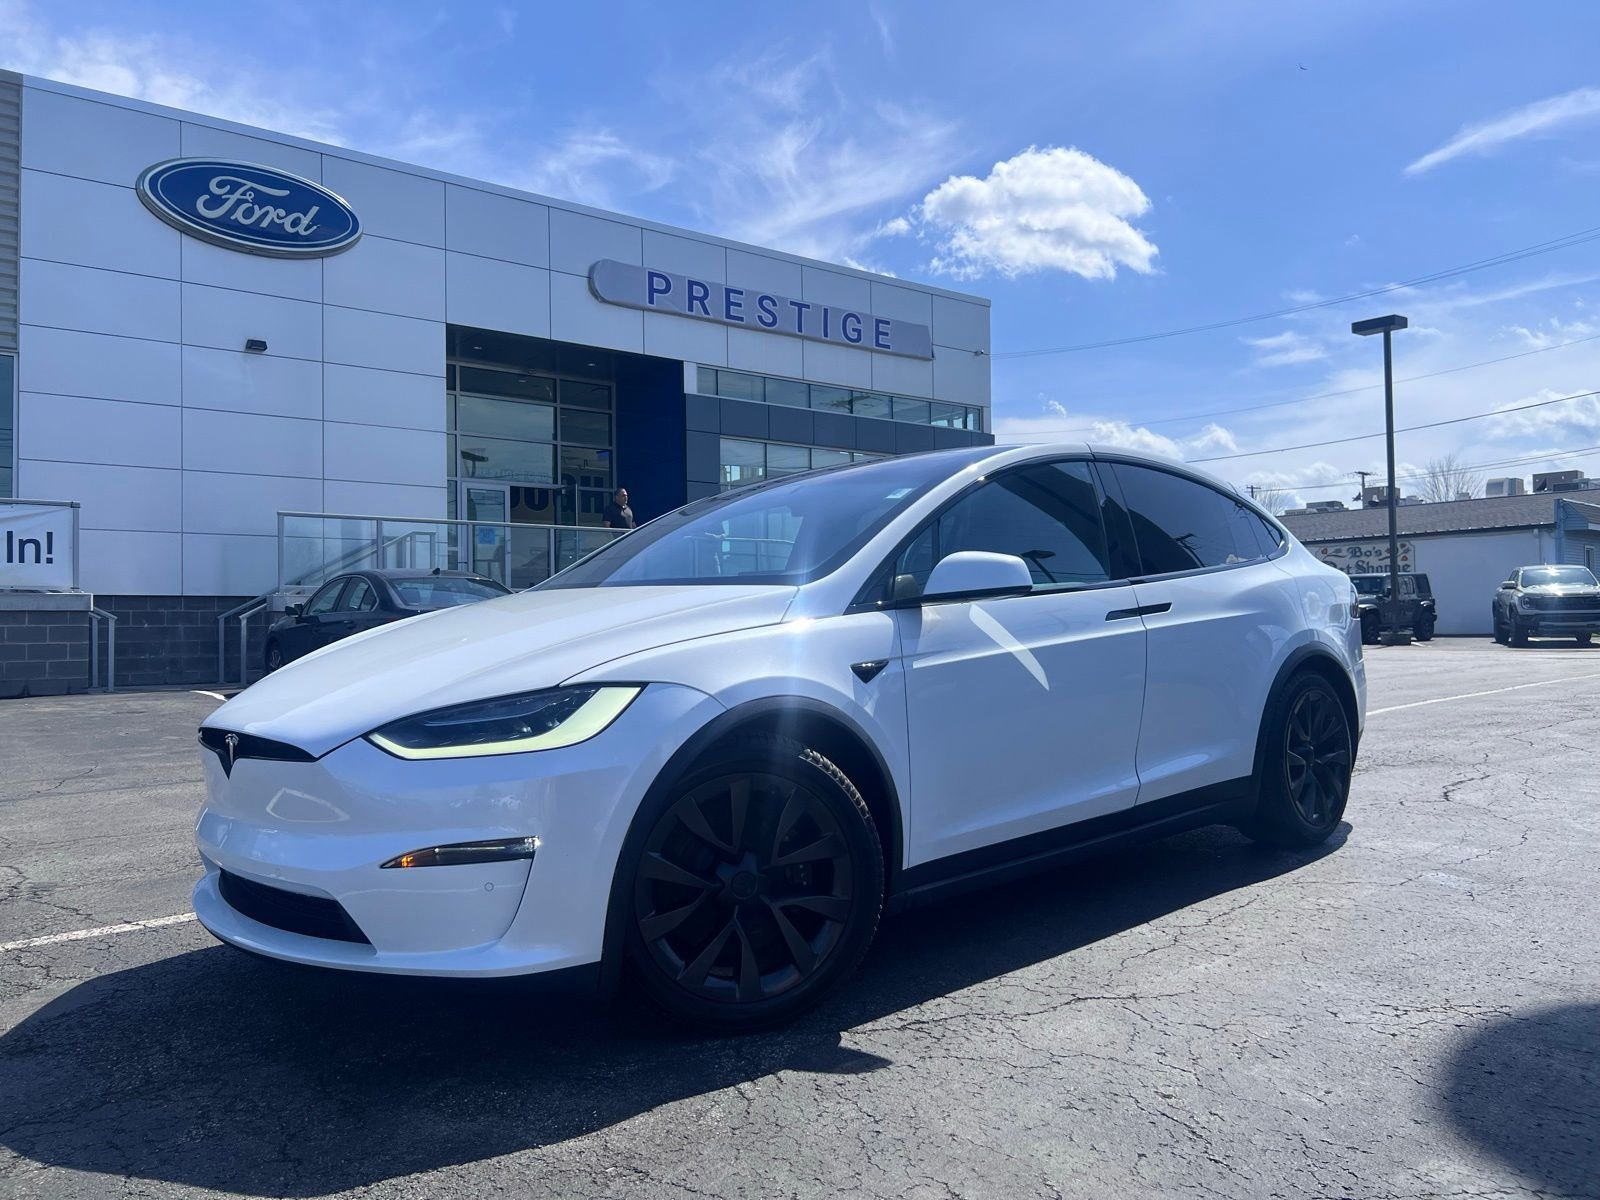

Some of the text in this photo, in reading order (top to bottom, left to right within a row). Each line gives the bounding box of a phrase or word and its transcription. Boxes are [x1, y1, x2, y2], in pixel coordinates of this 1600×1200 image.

[196, 175, 321, 235] Ford
[647, 270, 892, 350] PRESTIGE
[6, 530, 53, 564] In!
[1346, 546, 1383, 559] Bo's
[1355, 560, 1411, 574] Shope
